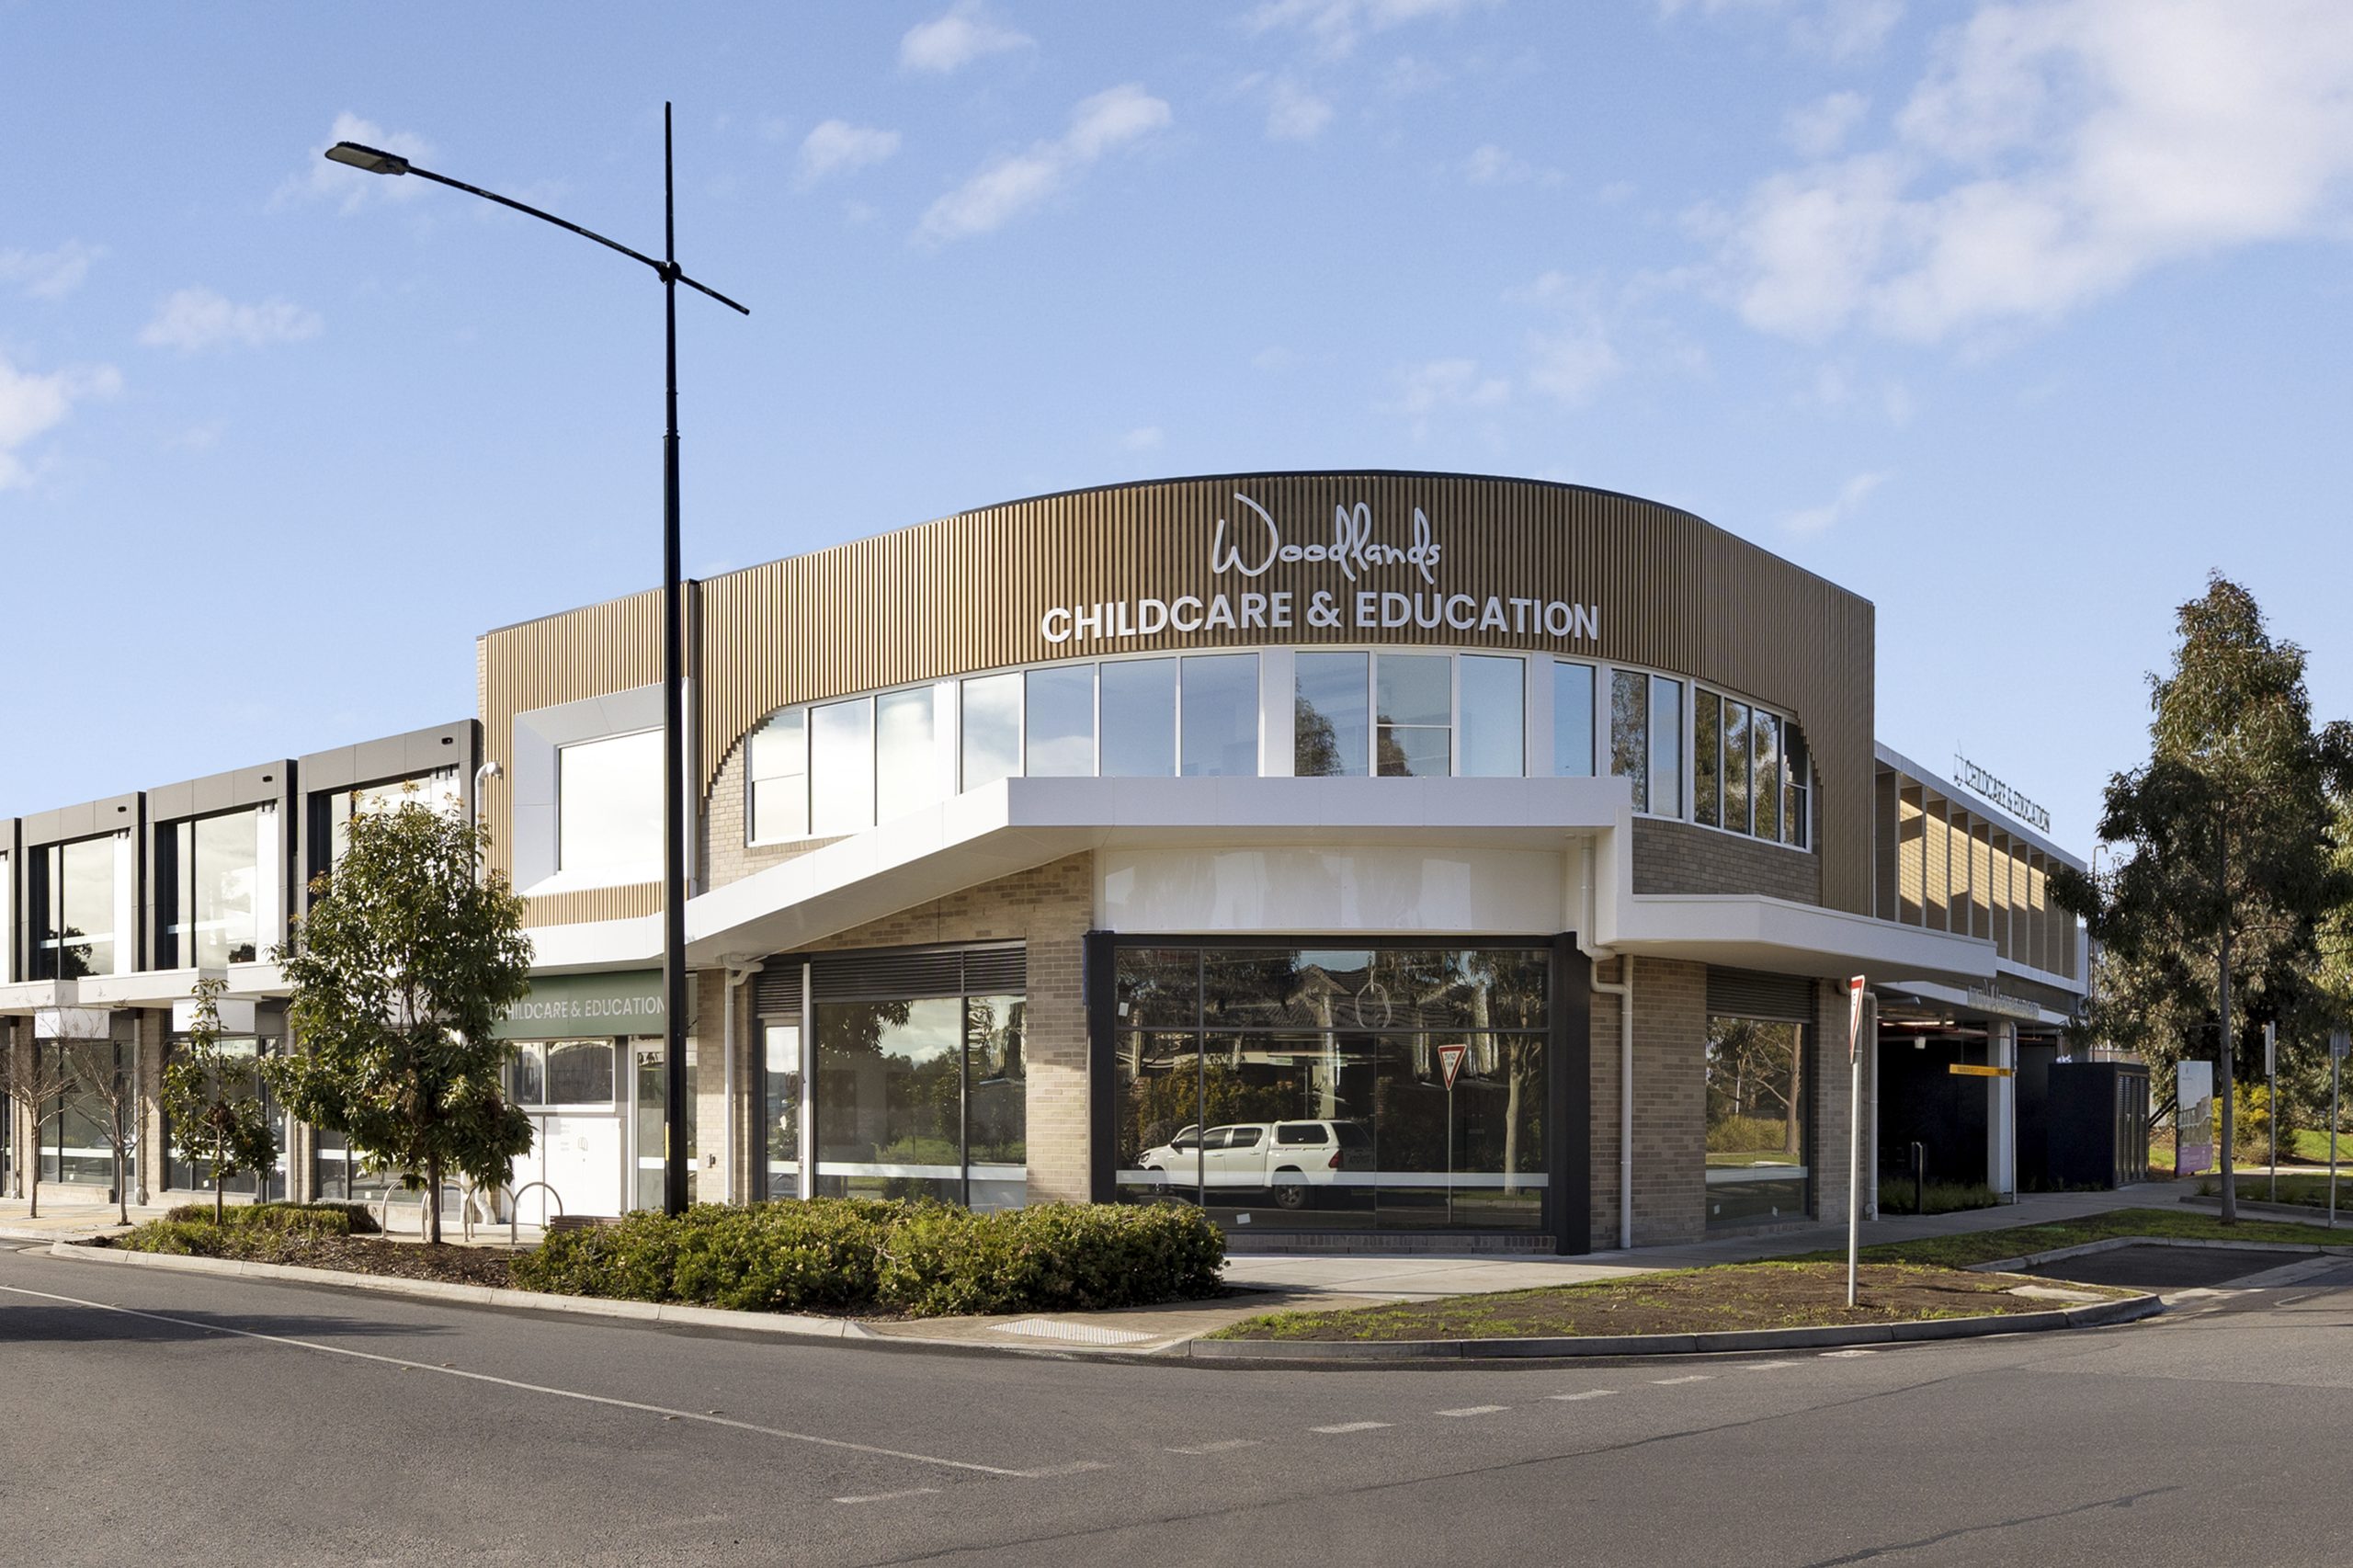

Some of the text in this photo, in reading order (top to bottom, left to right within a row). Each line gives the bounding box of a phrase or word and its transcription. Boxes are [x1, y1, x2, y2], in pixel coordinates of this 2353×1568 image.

[1212, 492, 1441, 585] Woodlands
[1041, 590, 1598, 643] CHILDCARE & EDUCATION
[570, 1000, 582, 1017] &
